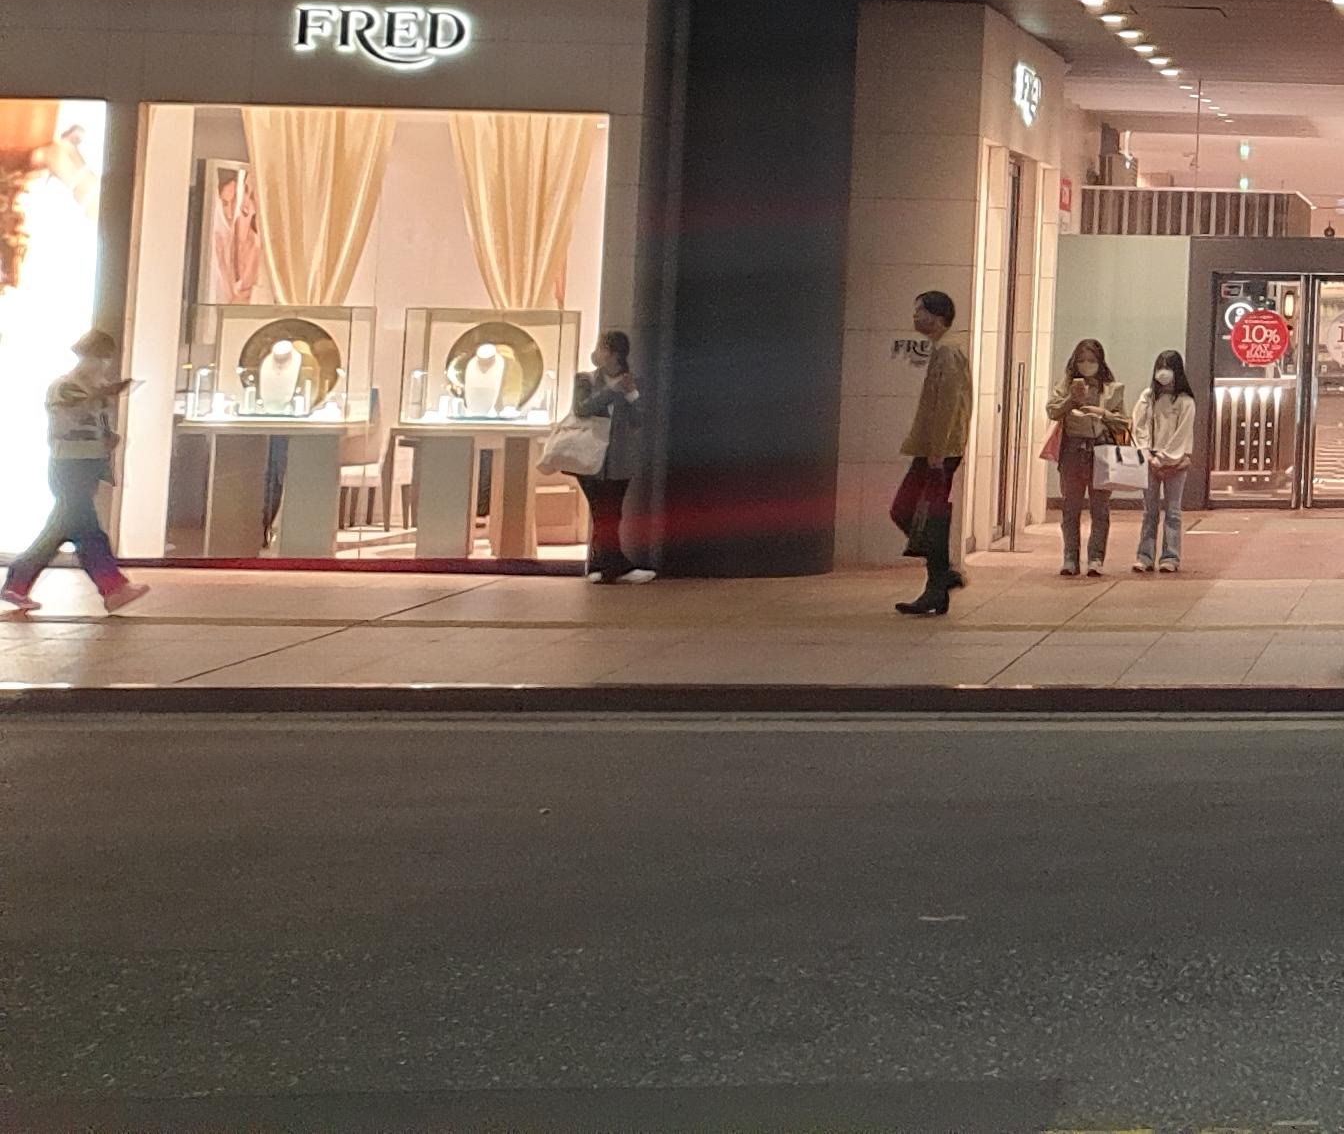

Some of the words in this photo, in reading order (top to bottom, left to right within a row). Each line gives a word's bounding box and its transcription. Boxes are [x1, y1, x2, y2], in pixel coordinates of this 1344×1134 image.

[295, 6, 467, 65] FRED
[1241, 325, 1281, 344] 10%
[894, 339, 930, 357] FRE
